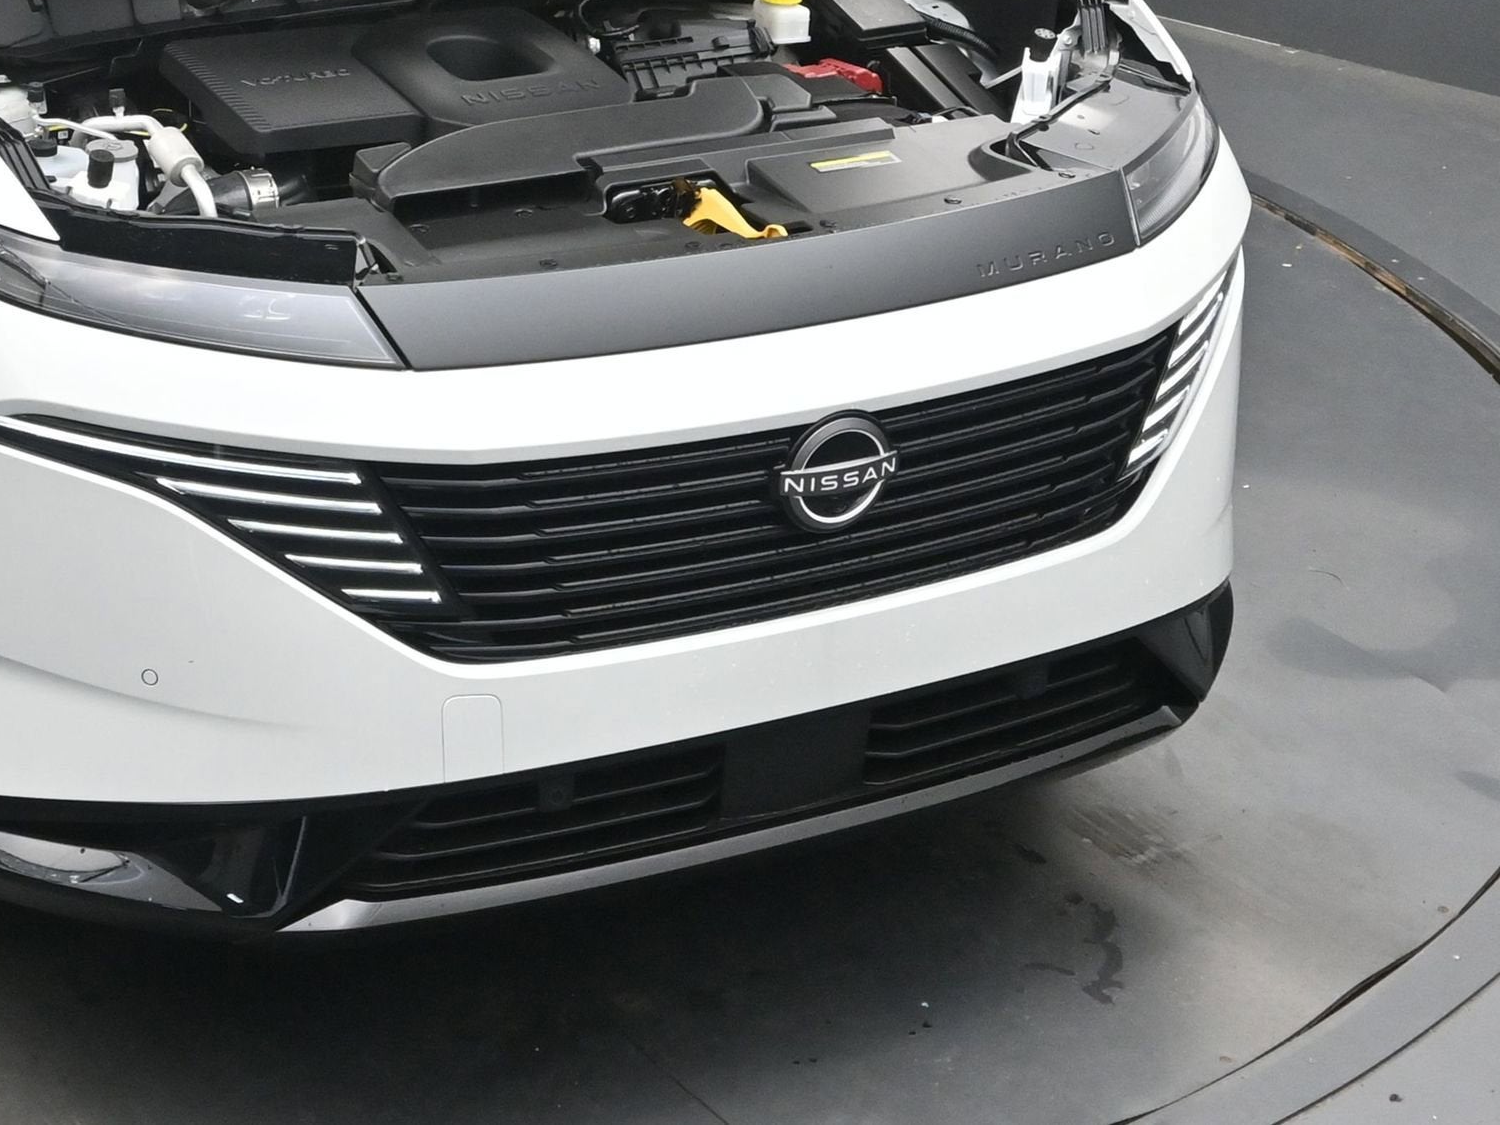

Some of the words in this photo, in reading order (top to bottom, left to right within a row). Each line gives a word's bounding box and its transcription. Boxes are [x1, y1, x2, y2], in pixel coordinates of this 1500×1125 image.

[461, 79, 601, 106] NISSAN
[976, 231, 1116, 277] MURANO
[784, 457, 896, 493] NISSAN
